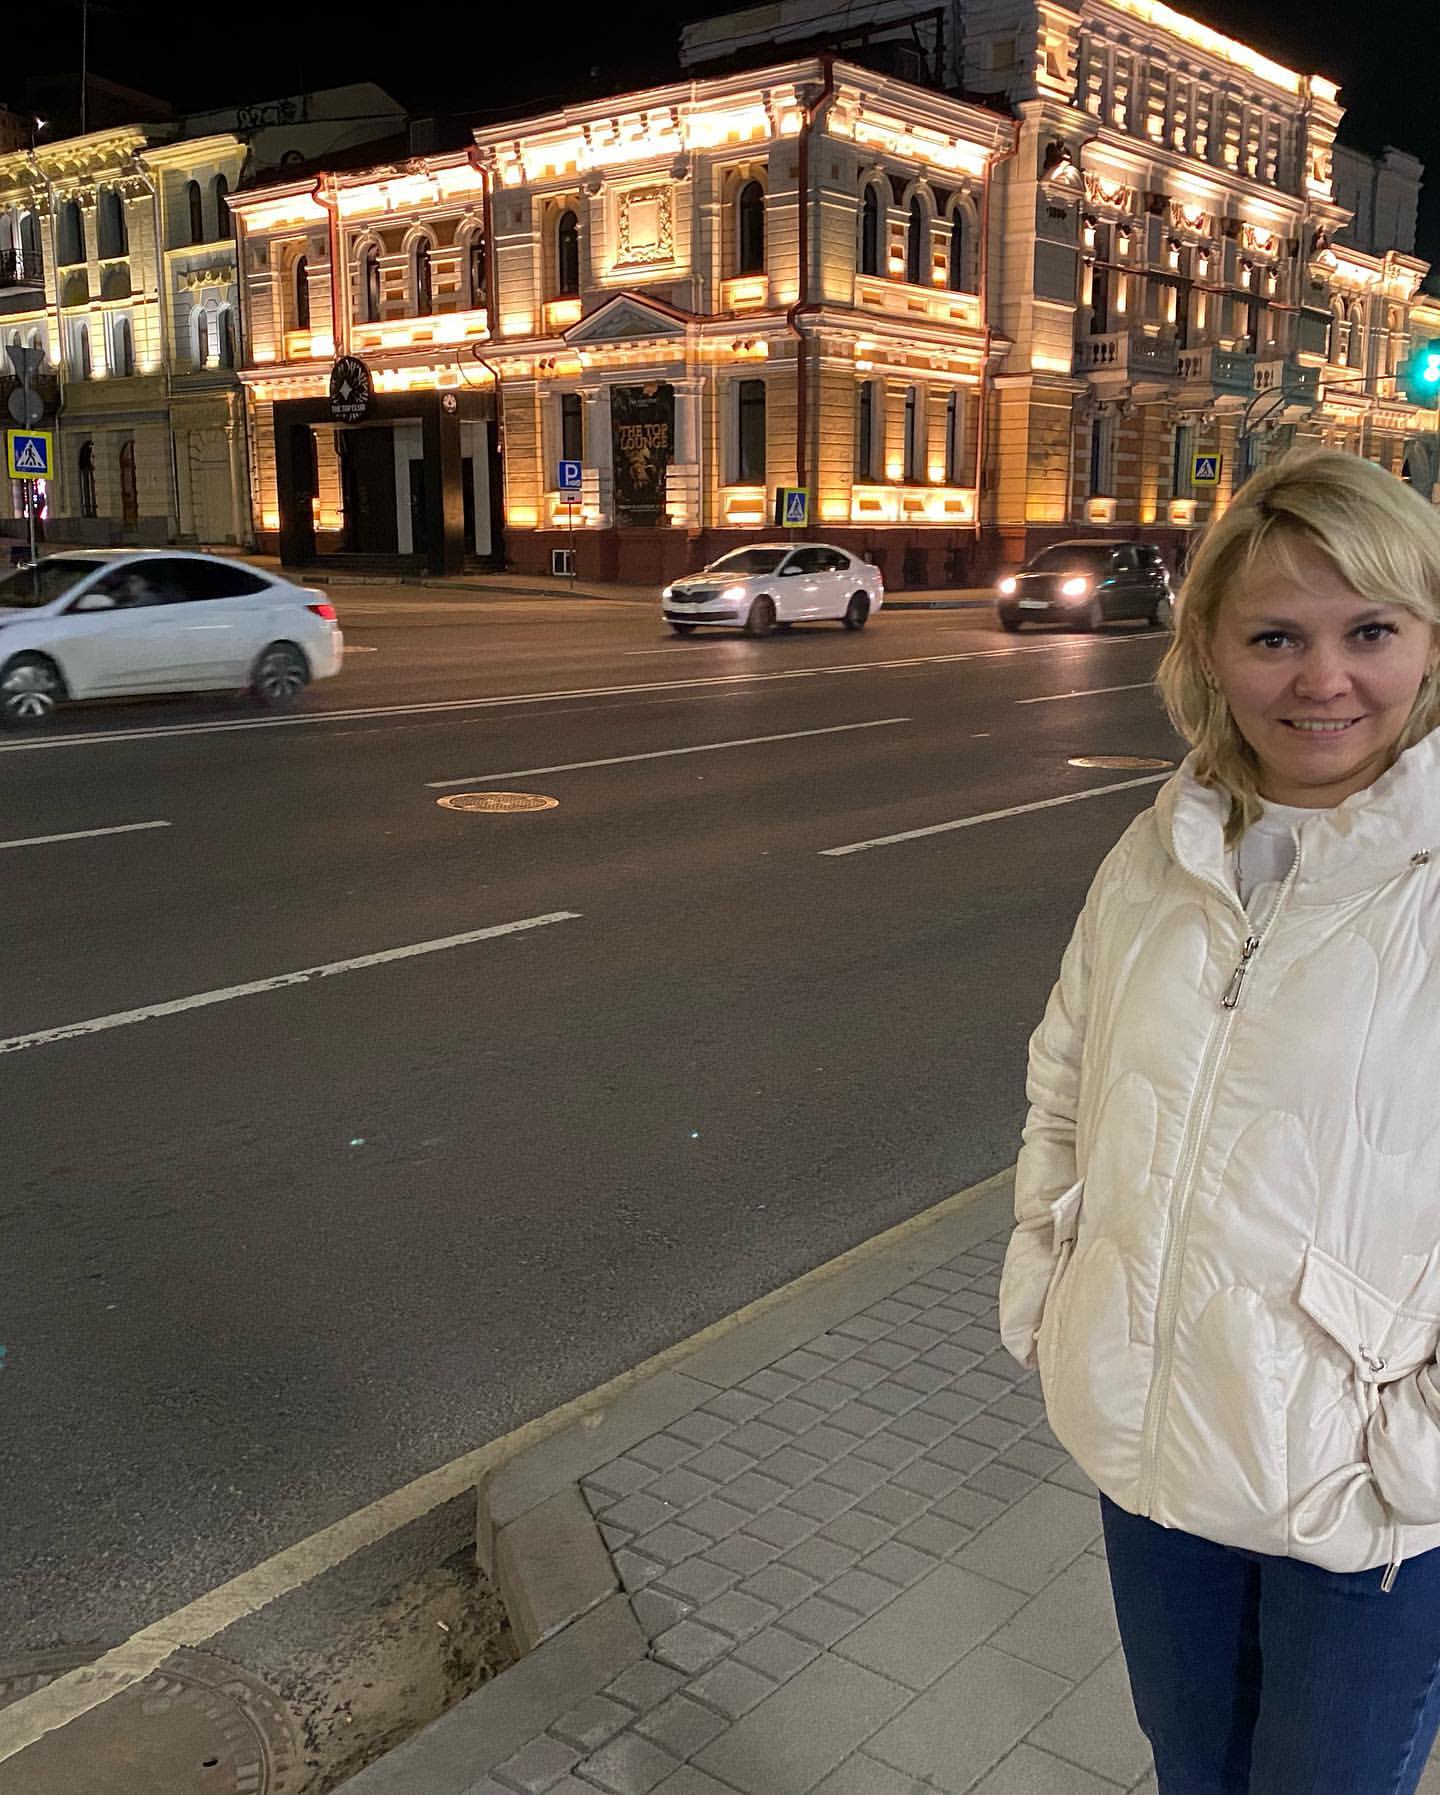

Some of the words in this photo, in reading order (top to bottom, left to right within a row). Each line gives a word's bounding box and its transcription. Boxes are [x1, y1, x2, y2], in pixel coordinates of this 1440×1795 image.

[620, 425, 642, 438] THE
[644, 424, 668, 437] TOP
[621, 436, 668, 450] LOUNGE
[565, 463, 578, 487] P
